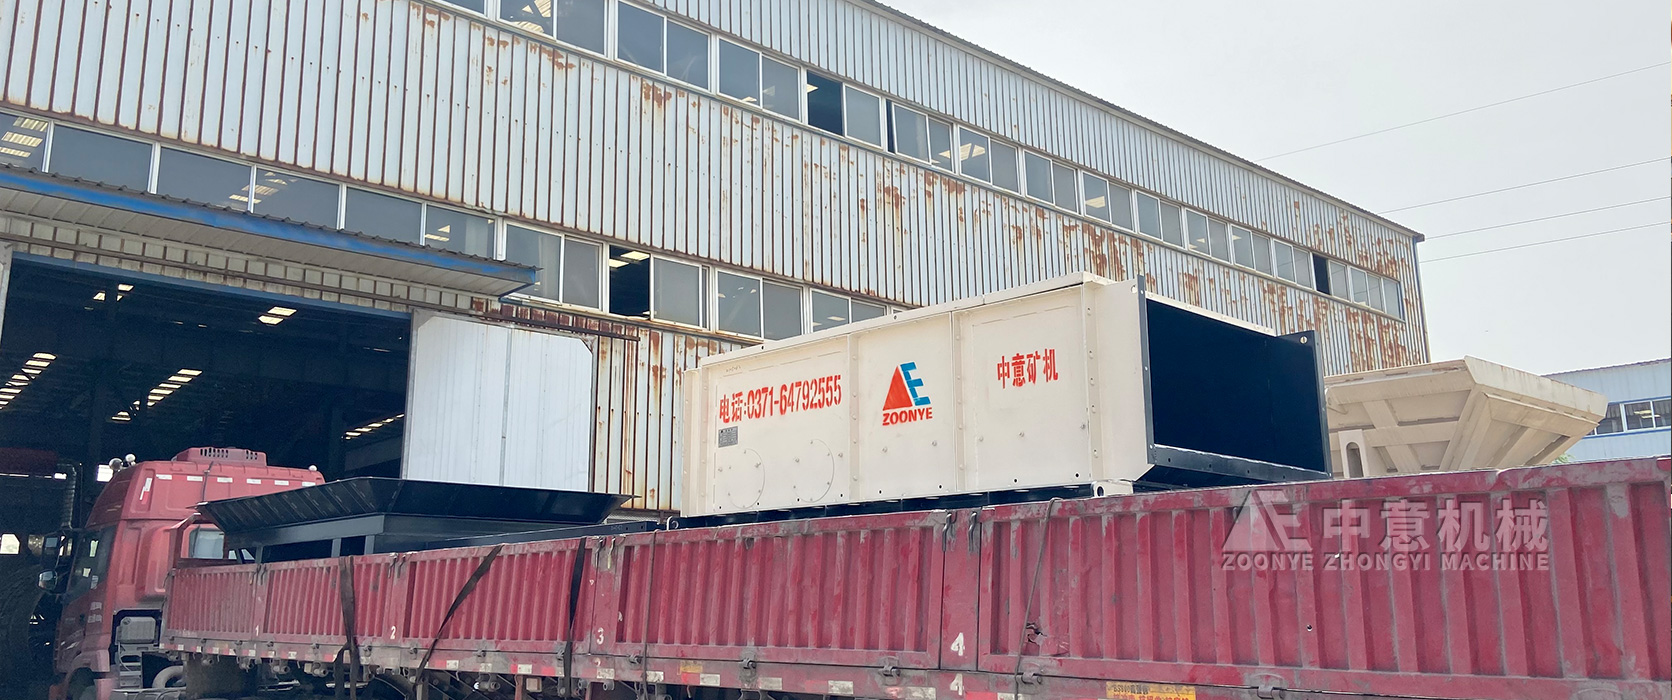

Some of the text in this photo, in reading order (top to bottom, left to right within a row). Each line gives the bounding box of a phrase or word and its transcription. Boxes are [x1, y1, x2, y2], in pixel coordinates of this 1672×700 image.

[997, 348, 1058, 389] 中意矿机
[718, 374, 842, 423] 电话:0371-64792555
[882, 407, 933, 426] ZOONYE
[390, 625, 397, 640] 2
[596, 627, 605, 645] 3
[950, 632, 966, 657] 4
[949, 673, 965, 696] 4
